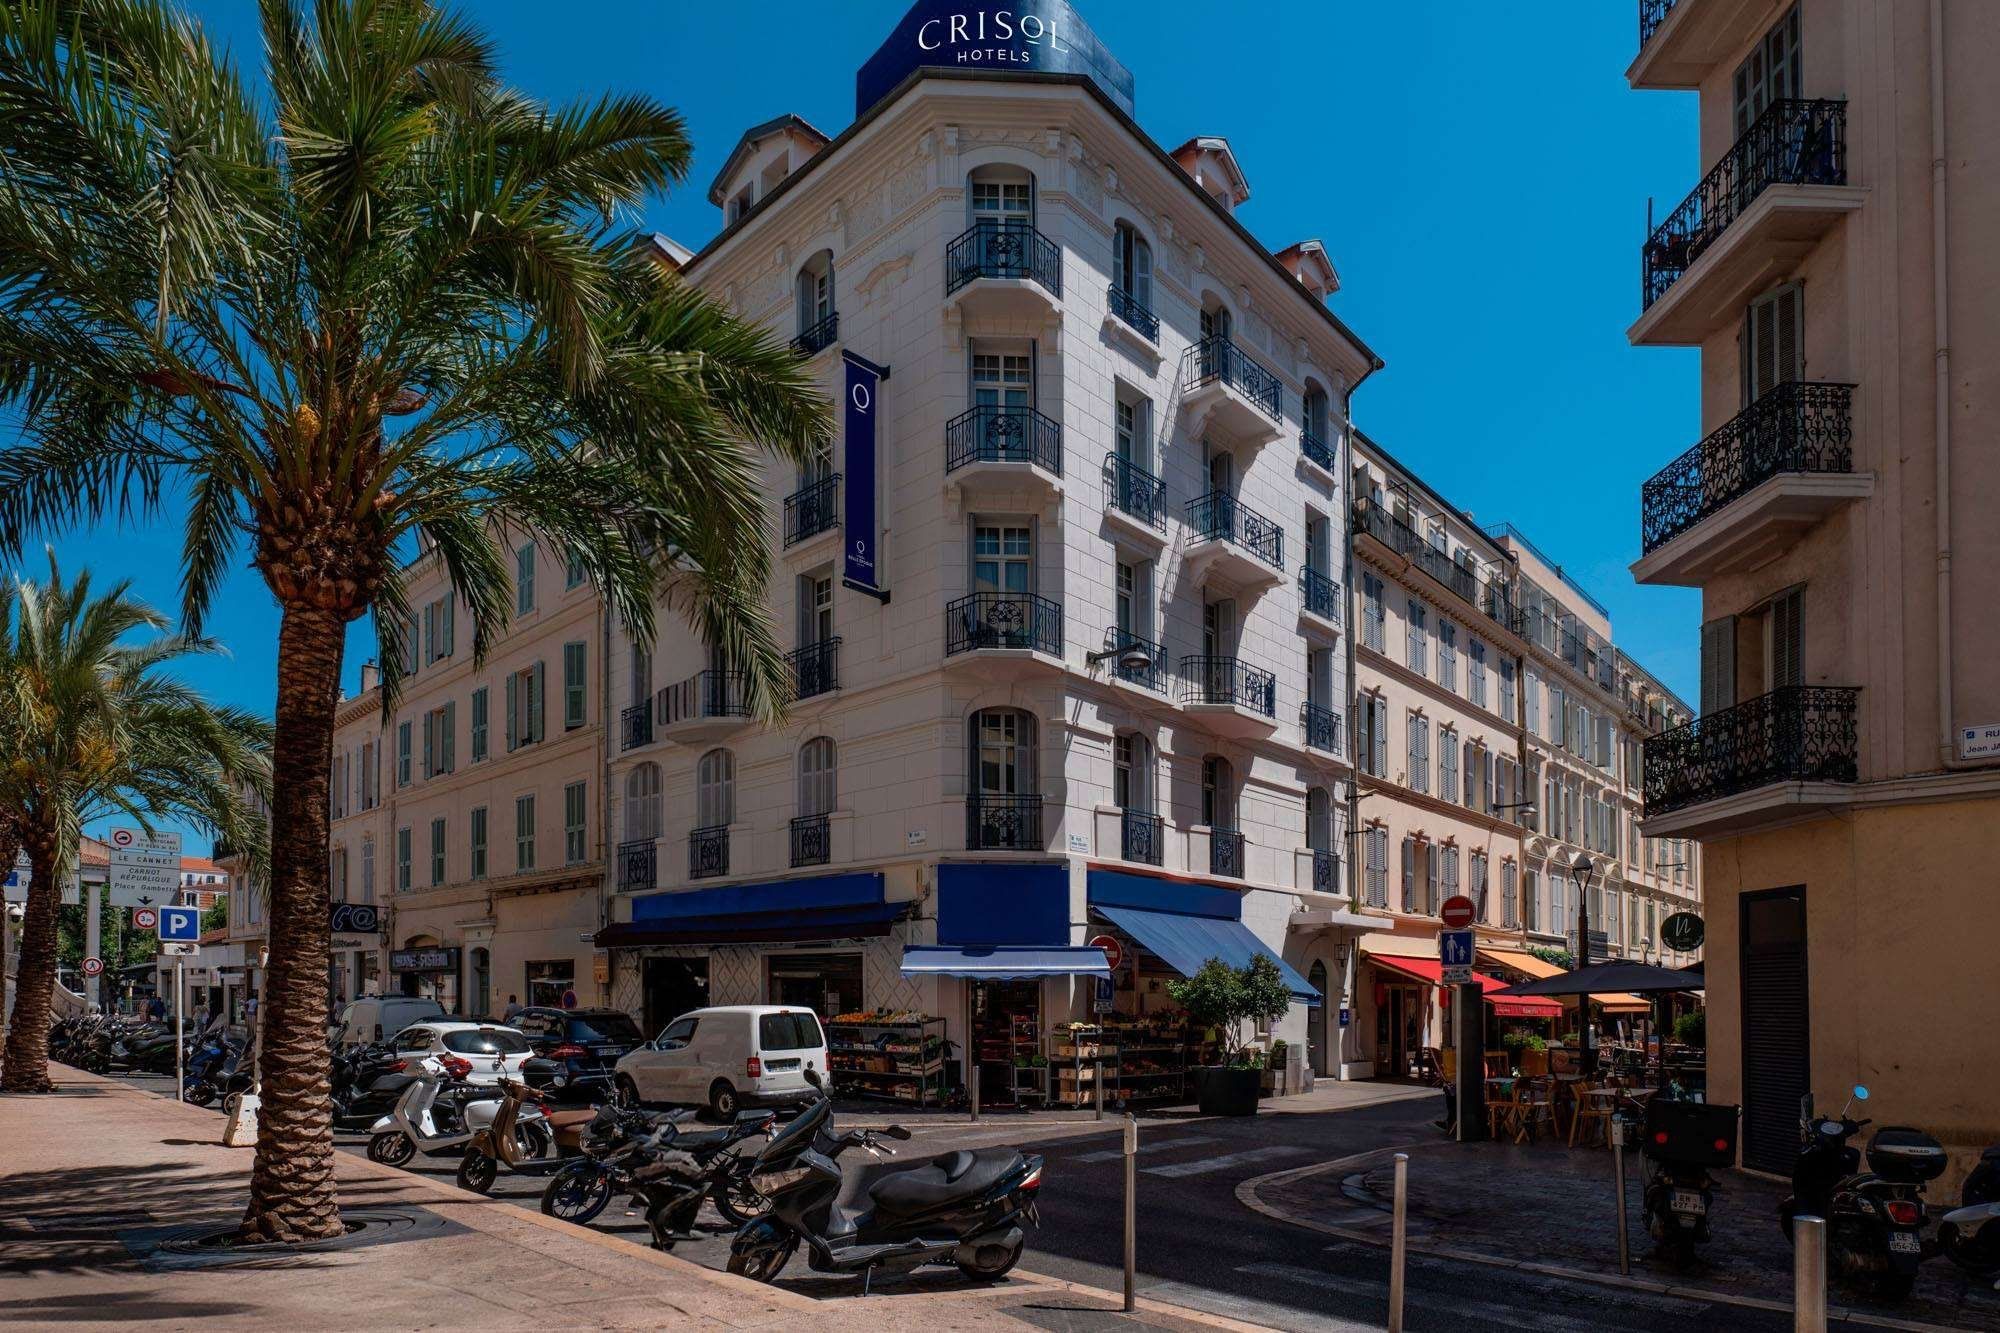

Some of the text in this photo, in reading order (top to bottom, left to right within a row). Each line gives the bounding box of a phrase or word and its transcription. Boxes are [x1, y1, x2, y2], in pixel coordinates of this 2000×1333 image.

[918, 11, 1069, 53] CRISOL
[957, 49, 1030, 63] HOTELS
[1966, 745, 1988, 753] Jean
[137, 856, 173, 865] CANNET
[129, 867, 161, 876] CARNOT
[120, 873, 171, 883] RÉPUBLIQUE
[114, 882, 136, 890] Place
[170, 913, 188, 934] P
